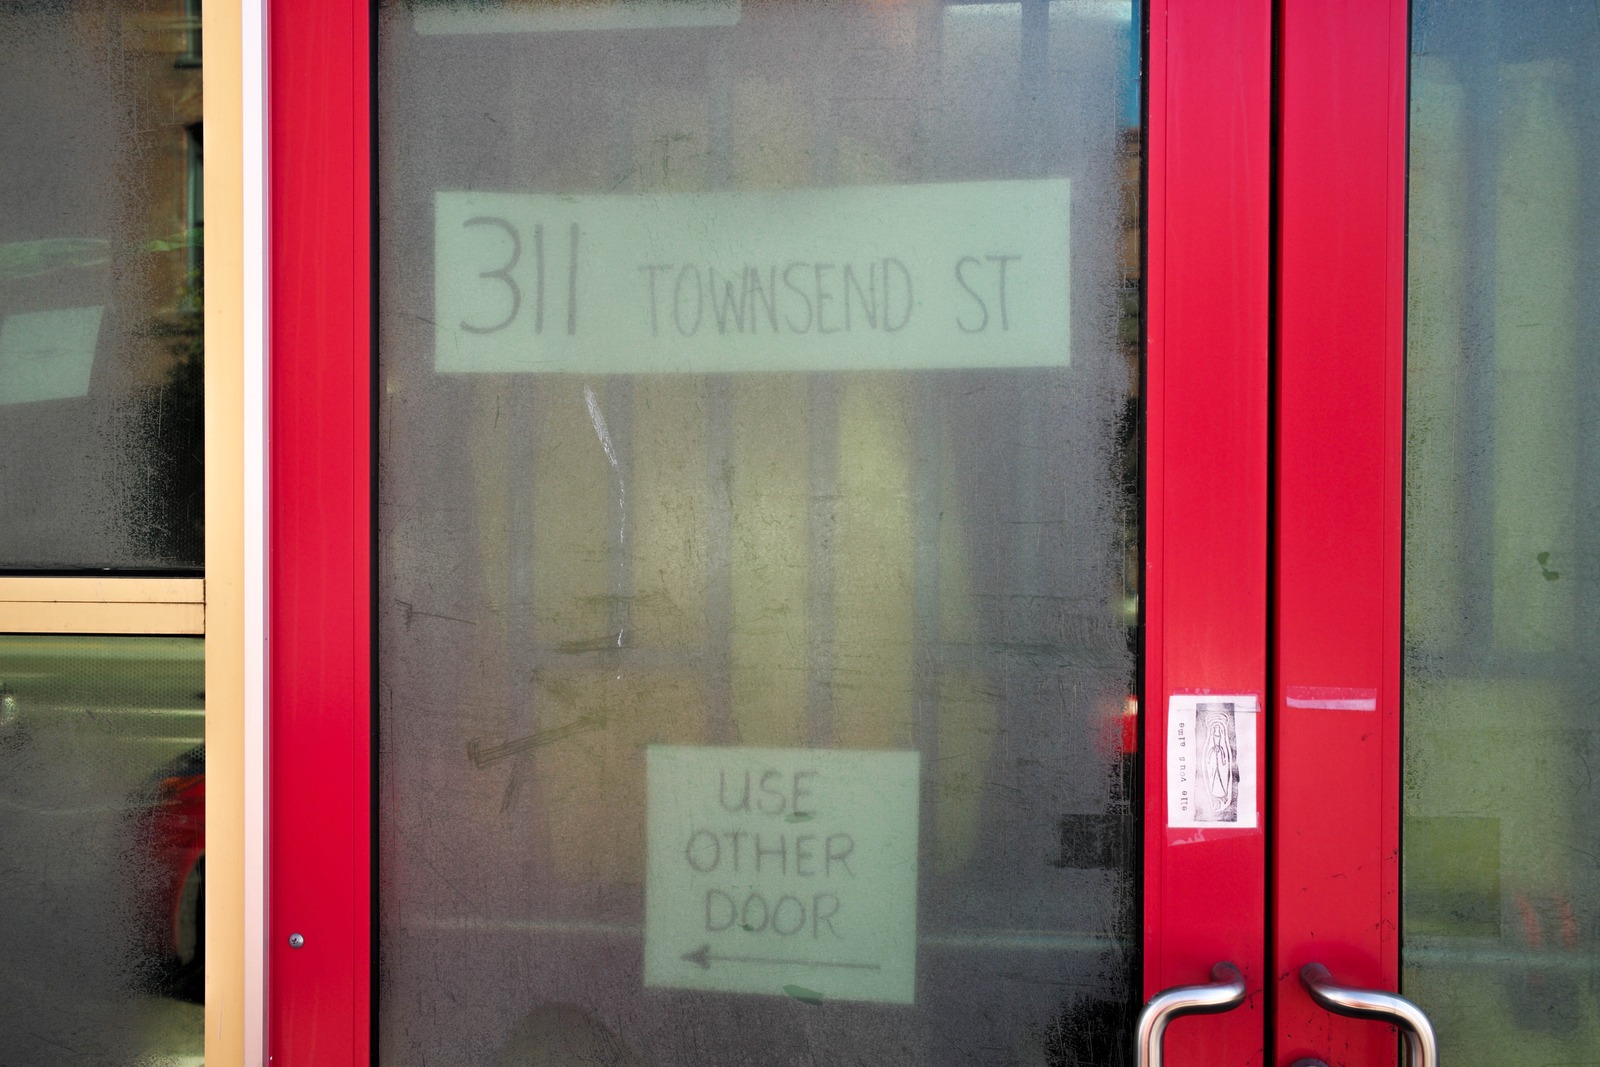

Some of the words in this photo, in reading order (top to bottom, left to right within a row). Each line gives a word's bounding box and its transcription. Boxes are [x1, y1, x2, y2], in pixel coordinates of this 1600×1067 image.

[460, 216, 580, 335] 311
[638, 257, 914, 337] TOWNSEND
[955, 255, 1022, 334] ST
[1177, 722, 1186, 747] aime
[720, 768, 819, 816] USE
[1179, 756, 1188, 782] vous
[1180, 791, 1188, 811] elle
[685, 829, 856, 878] OTHER
[705, 889, 844, 940] DOOR
